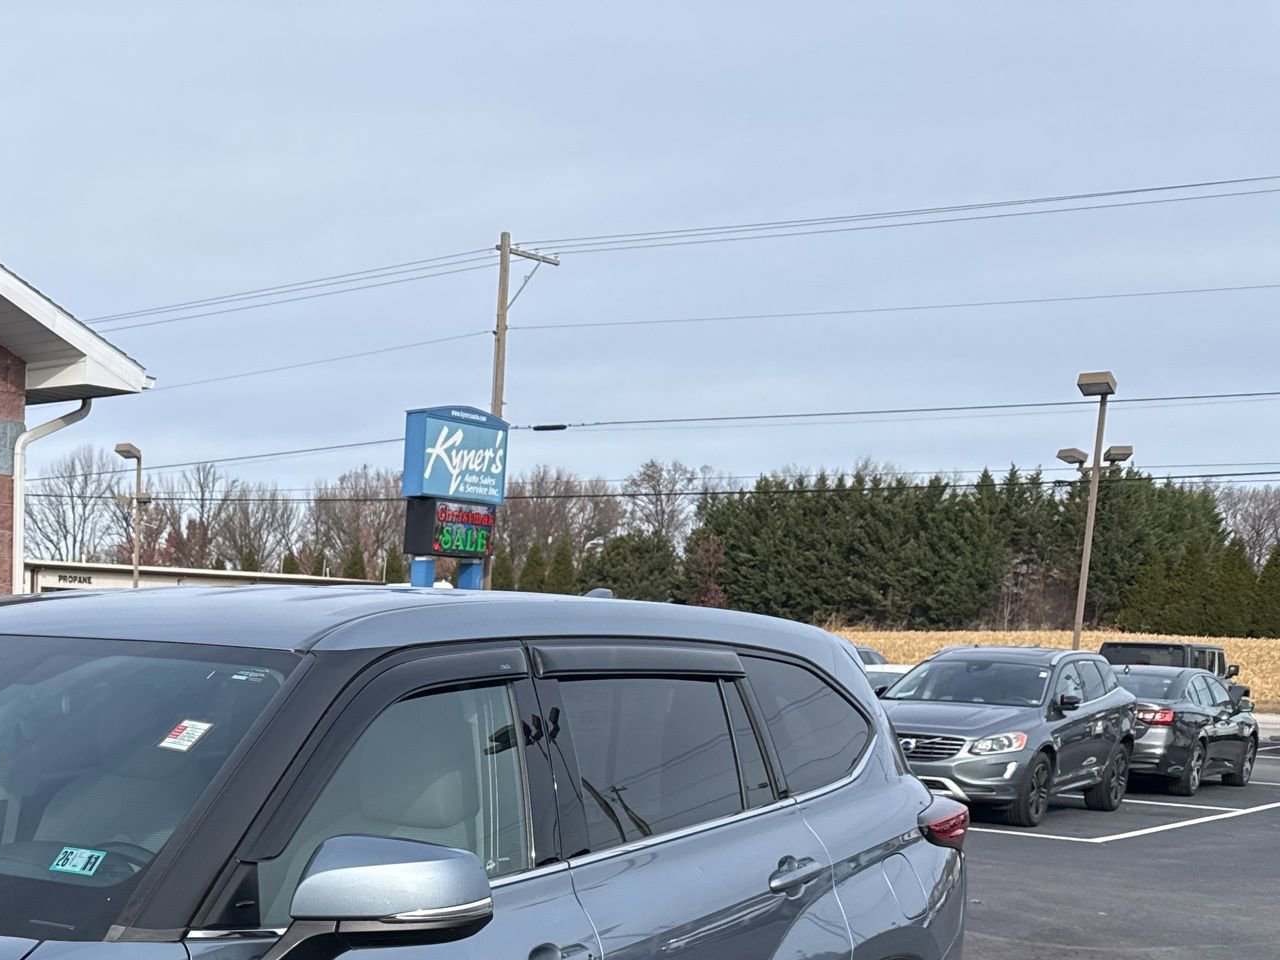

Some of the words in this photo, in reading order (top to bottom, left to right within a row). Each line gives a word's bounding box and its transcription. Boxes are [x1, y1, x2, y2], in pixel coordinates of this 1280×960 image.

[424, 425, 503, 495] Kyner's
[464, 474, 480, 484] Auto
[480, 475, 496, 486] Sales
[465, 483, 488, 495] Service
[437, 504, 495, 527] Christmas
[440, 527, 488, 553] SALE
[58, 574, 92, 585] PROPANE
[56, 850, 74, 867] 26
